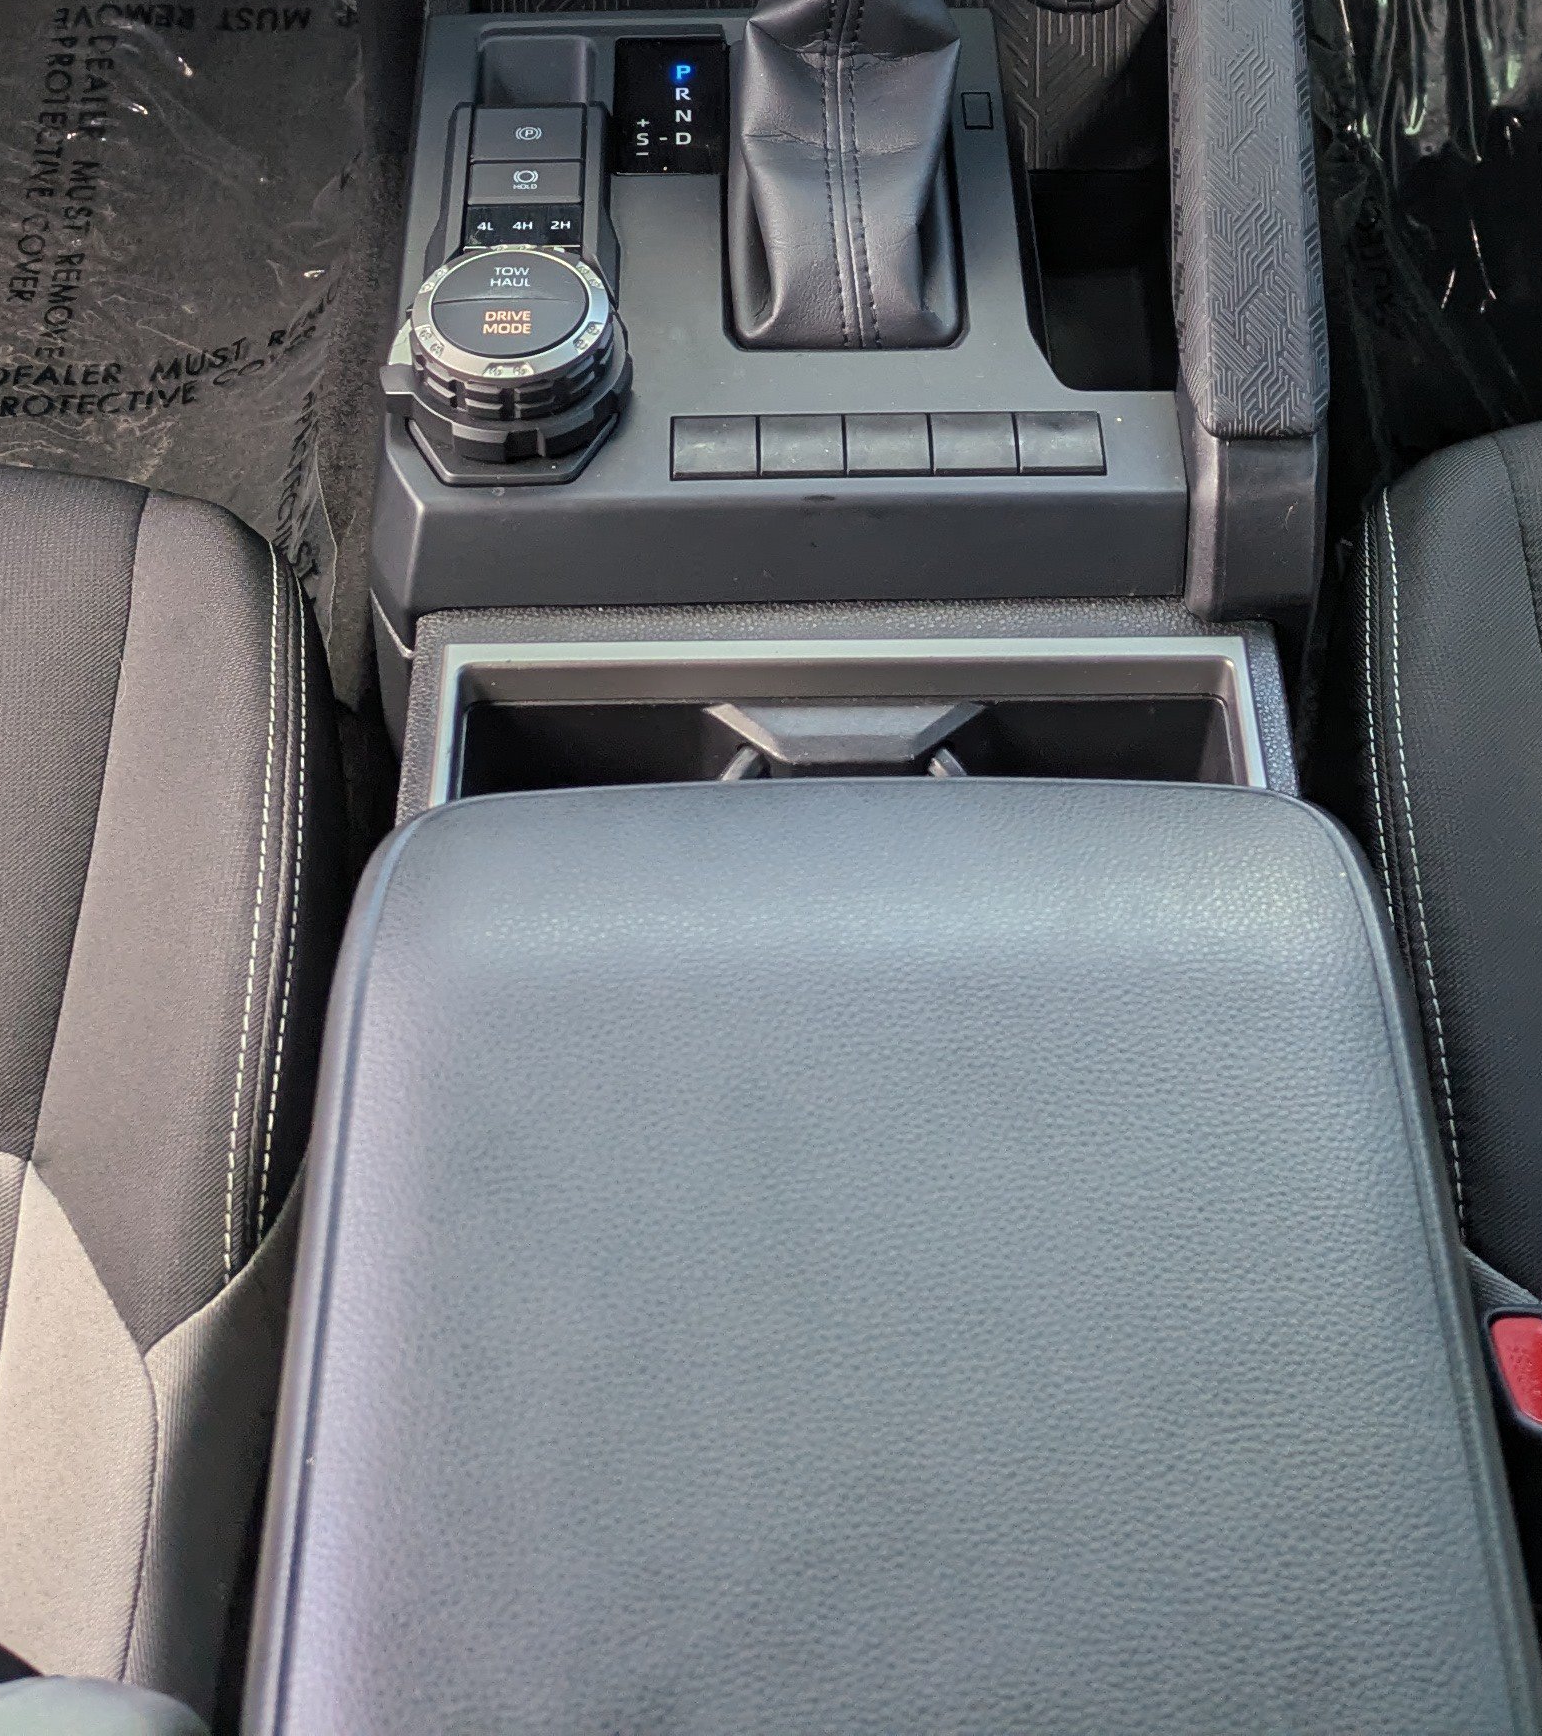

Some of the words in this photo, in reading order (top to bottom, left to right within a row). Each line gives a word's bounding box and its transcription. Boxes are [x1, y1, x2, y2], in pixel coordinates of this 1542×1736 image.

[676, 65, 691, 79] P
[676, 87, 691, 101] R
[675, 109, 691, 123] N
[636, 133, 649, 146] S
[675, 132, 692, 145] D
[64, 161, 100, 238] MUST
[477, 221, 494, 231] 4L
[512, 221, 533, 231] 4H
[550, 220, 571, 230] 2H
[8, 216, 49, 303] COVER
[494, 266, 530, 276] TOW
[490, 277, 531, 287] HAUL
[484, 310, 532, 322] DRIVE
[482, 323, 532, 335] MODE
[149, 336, 248, 384] MUST
